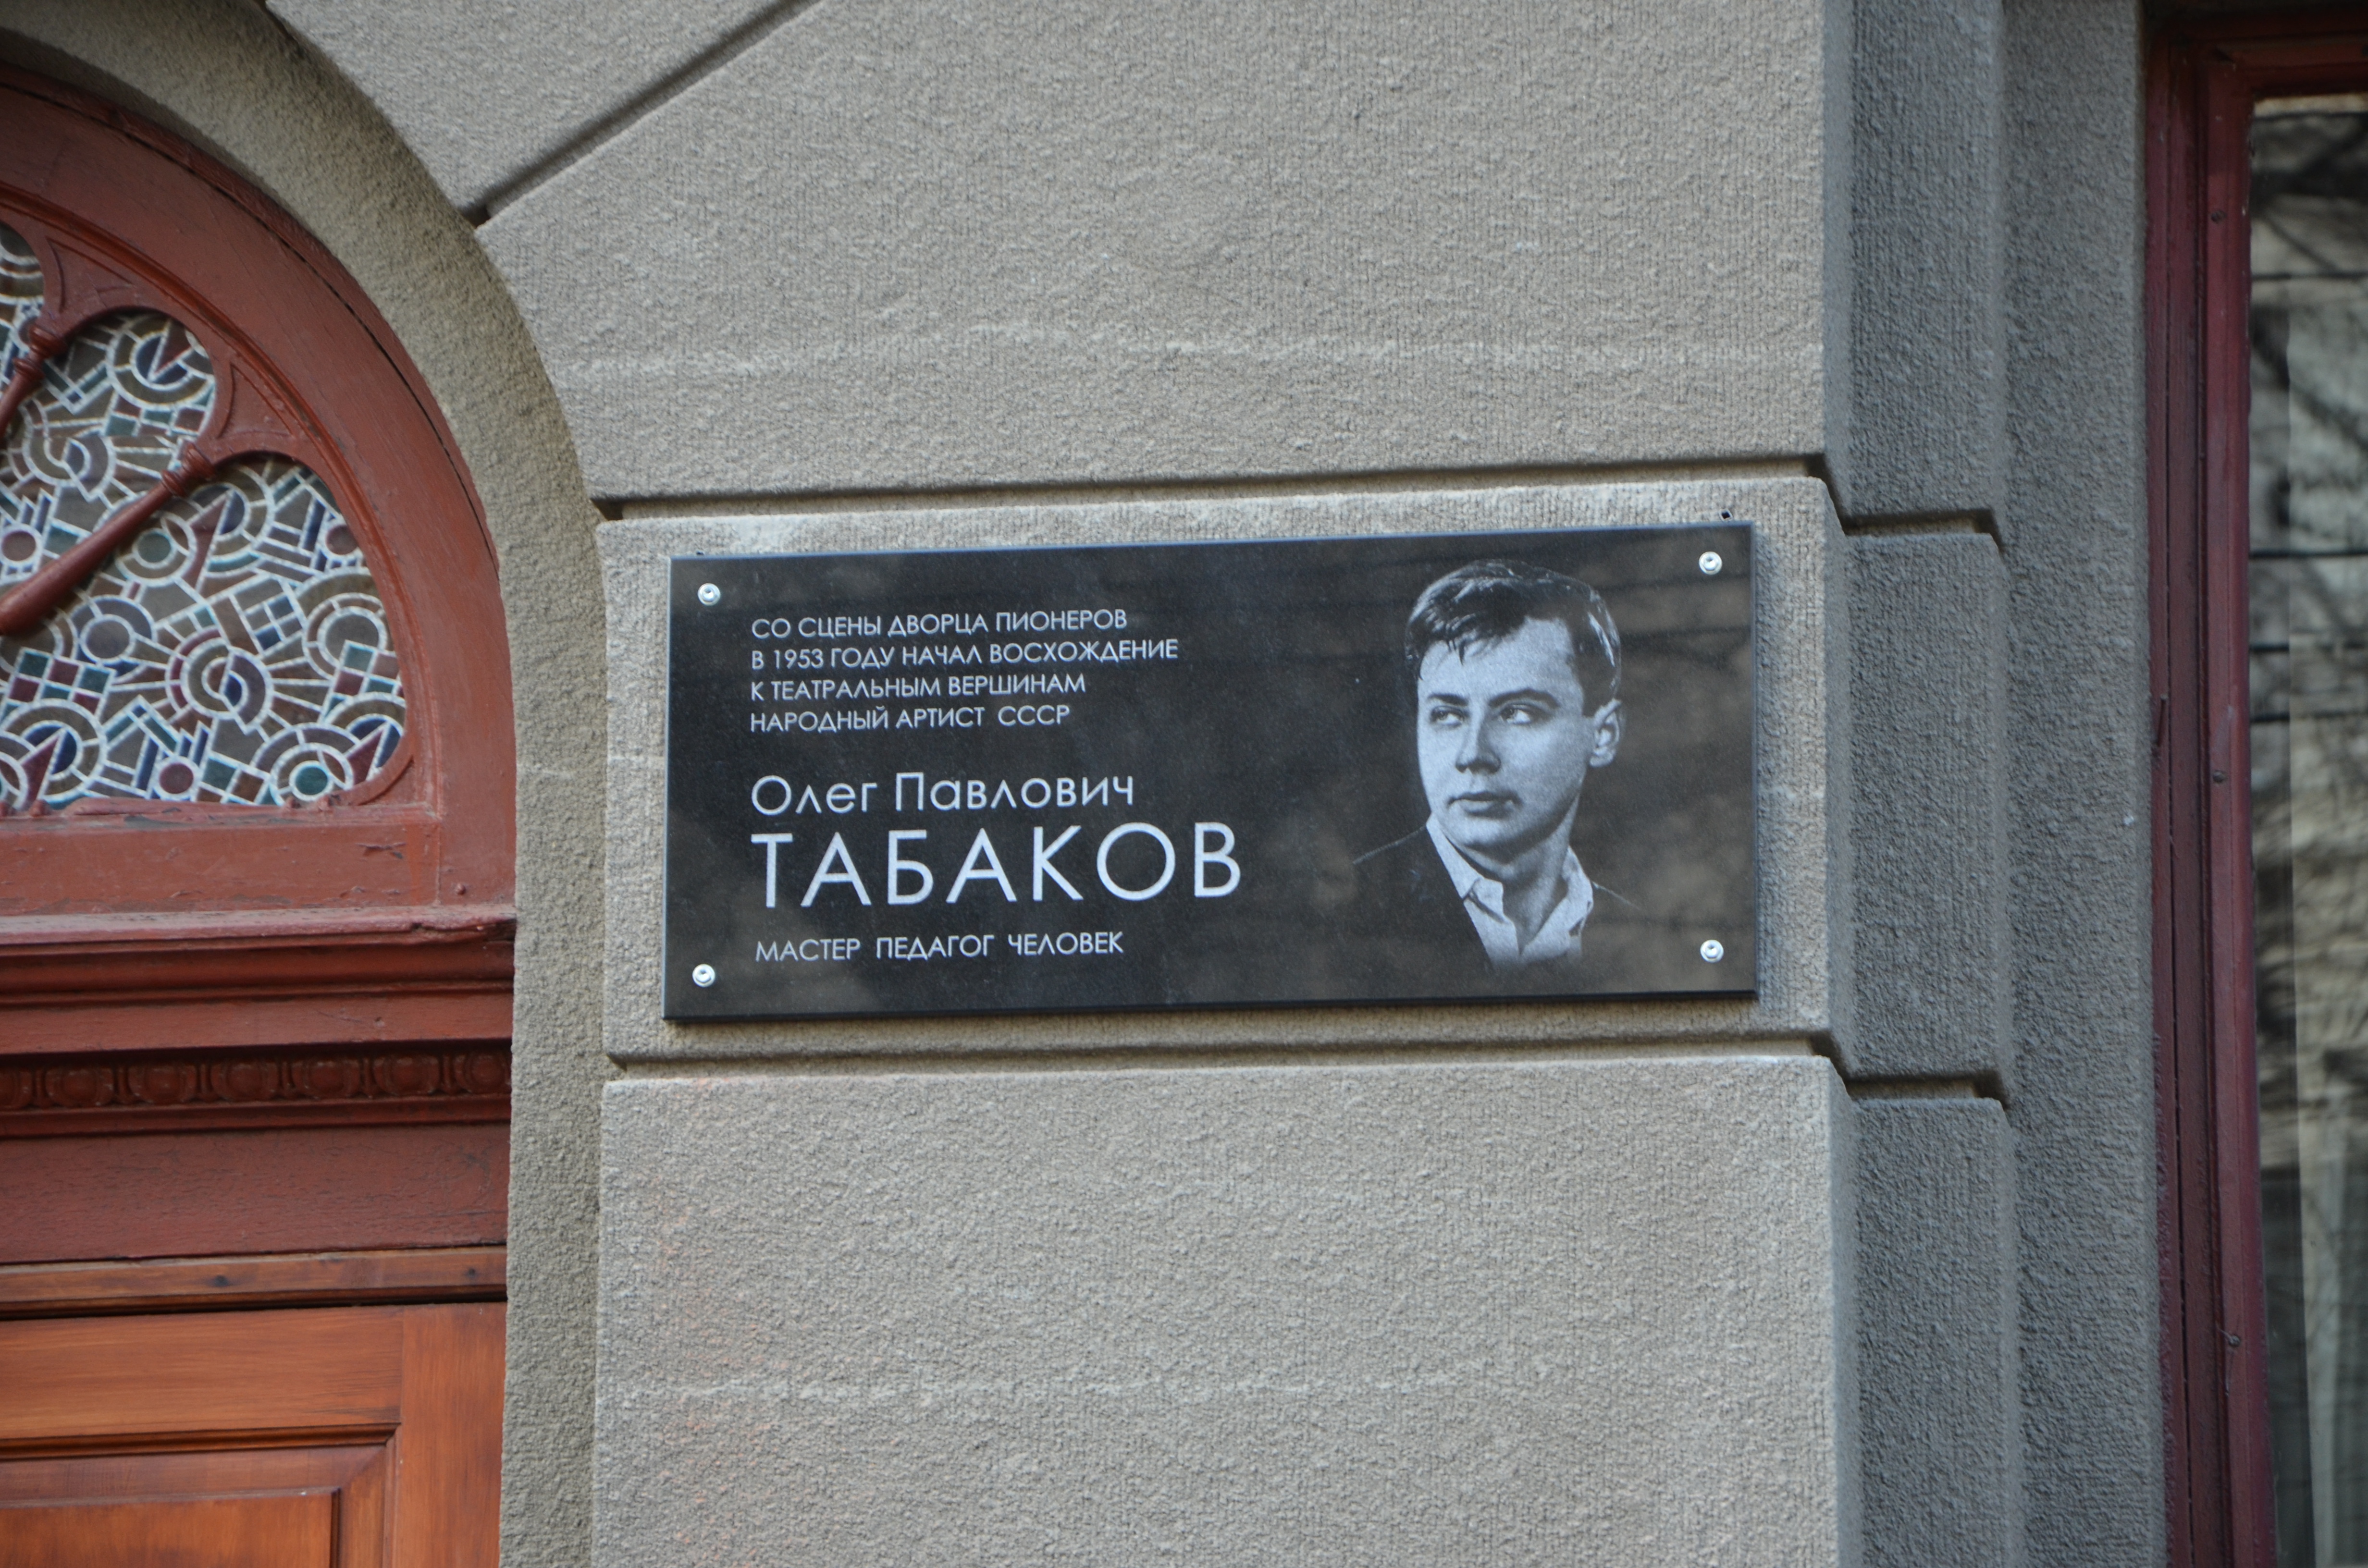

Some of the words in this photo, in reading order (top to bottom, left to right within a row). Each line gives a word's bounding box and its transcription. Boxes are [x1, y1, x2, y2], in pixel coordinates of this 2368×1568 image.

[752, 618, 791, 639] СО
[798, 616, 881, 639] СЦЕНЫ
[888, 613, 989, 637] ДВОРЦА
[996, 609, 1127, 632] ПИОНЕРОВ
[752, 650, 764, 670] В
[774, 648, 824, 669] 1953
[831, 646, 895, 669] ГОДУ
[902, 645, 982, 665] НАЧАЛ
[990, 638, 1178, 663] ВОСХОЖДЕНИЕ
[752, 681, 764, 701] К
[771, 677, 941, 700] ТЕАТРАЛЬНЫМ
[949, 673, 1085, 696] ВЕРШИНАМ
[751, 705, 888, 733] НАРОДНЫЙ
[895, 706, 985, 729] АРТИСТ
[998, 704, 1070, 726] СССР
[751, 775, 877, 815] Олег
[896, 772, 1134, 811] Павлович
[751, 822, 1241, 908] ТАБАКОВ
[755, 938, 861, 962] МАСТЕР
[876, 934, 995, 961] ПЕДАГОГ
[1008, 931, 1123, 956] ЧЕЛОВЕК
